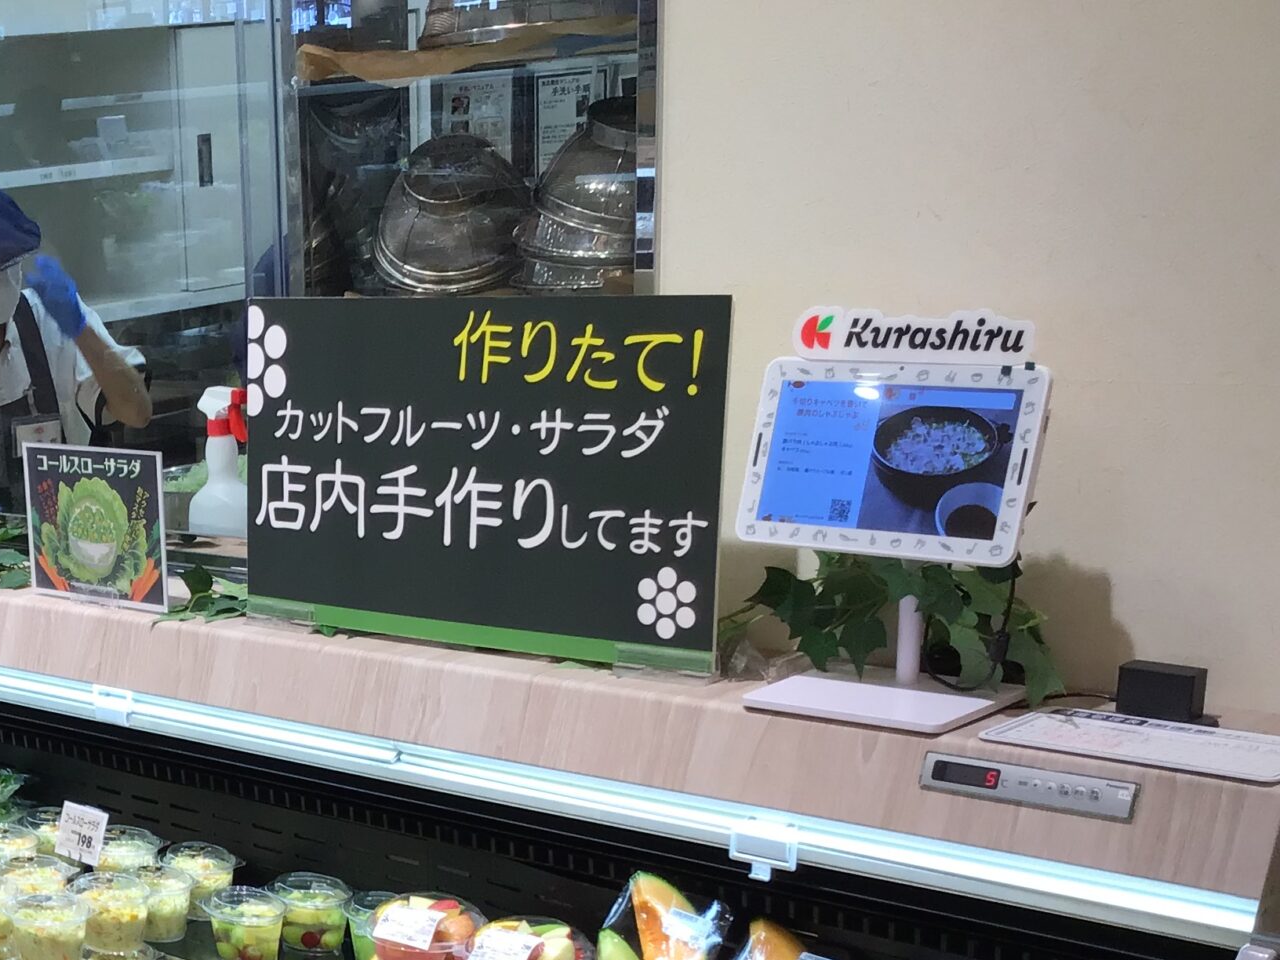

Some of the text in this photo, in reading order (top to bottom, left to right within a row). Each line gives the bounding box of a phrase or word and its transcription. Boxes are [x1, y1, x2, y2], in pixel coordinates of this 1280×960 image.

[454, 310, 704, 395] 作りたて!
[843, 317, 1026, 354] Kurashiru
[274, 400, 670, 458] カットフルーツ・サラダ
[37, 454, 142, 479] コールスローサラダ
[256, 455, 709, 558] 店内手作りしてます
